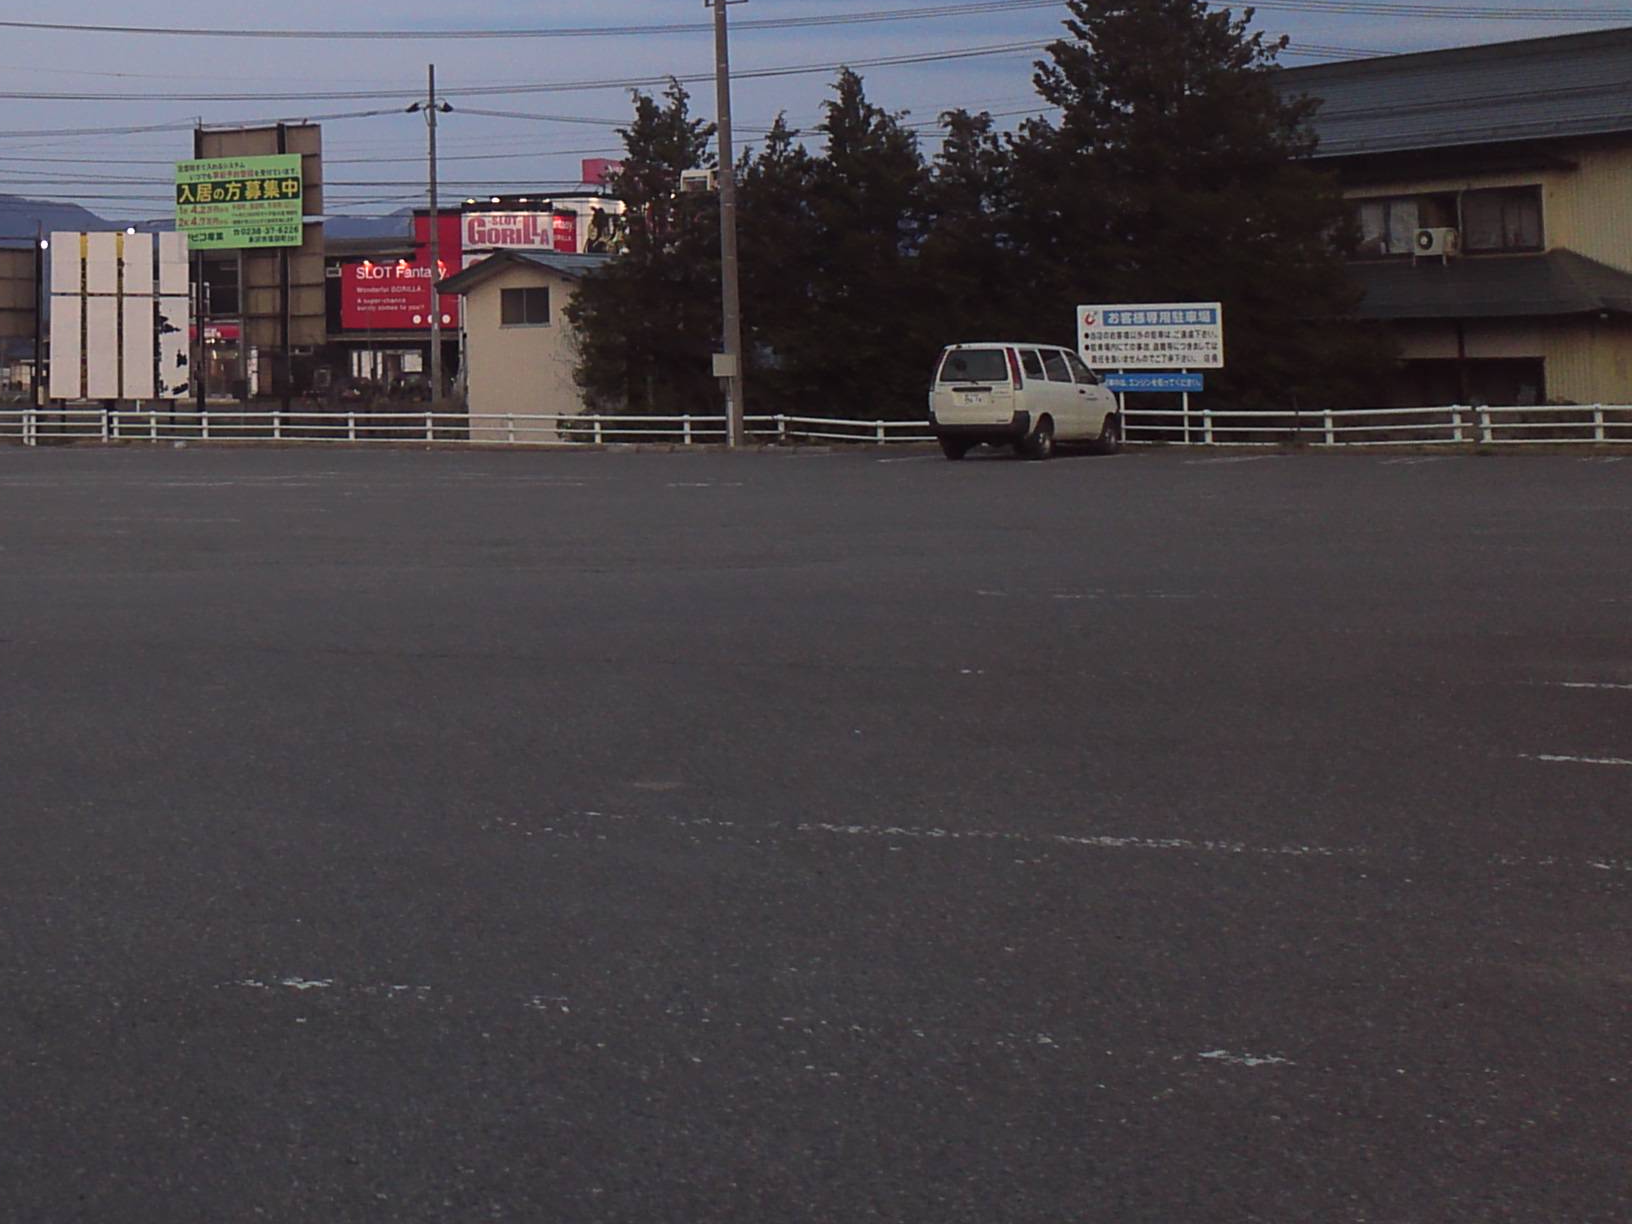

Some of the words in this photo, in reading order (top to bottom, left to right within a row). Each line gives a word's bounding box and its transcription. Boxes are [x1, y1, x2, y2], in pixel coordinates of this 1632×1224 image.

[179, 179, 298, 203] 入居の方募集中
[356, 266, 393, 280] SLOT
[396, 266, 447, 281] Fantay
[1107, 310, 1211, 325] お客様専用駐車場
